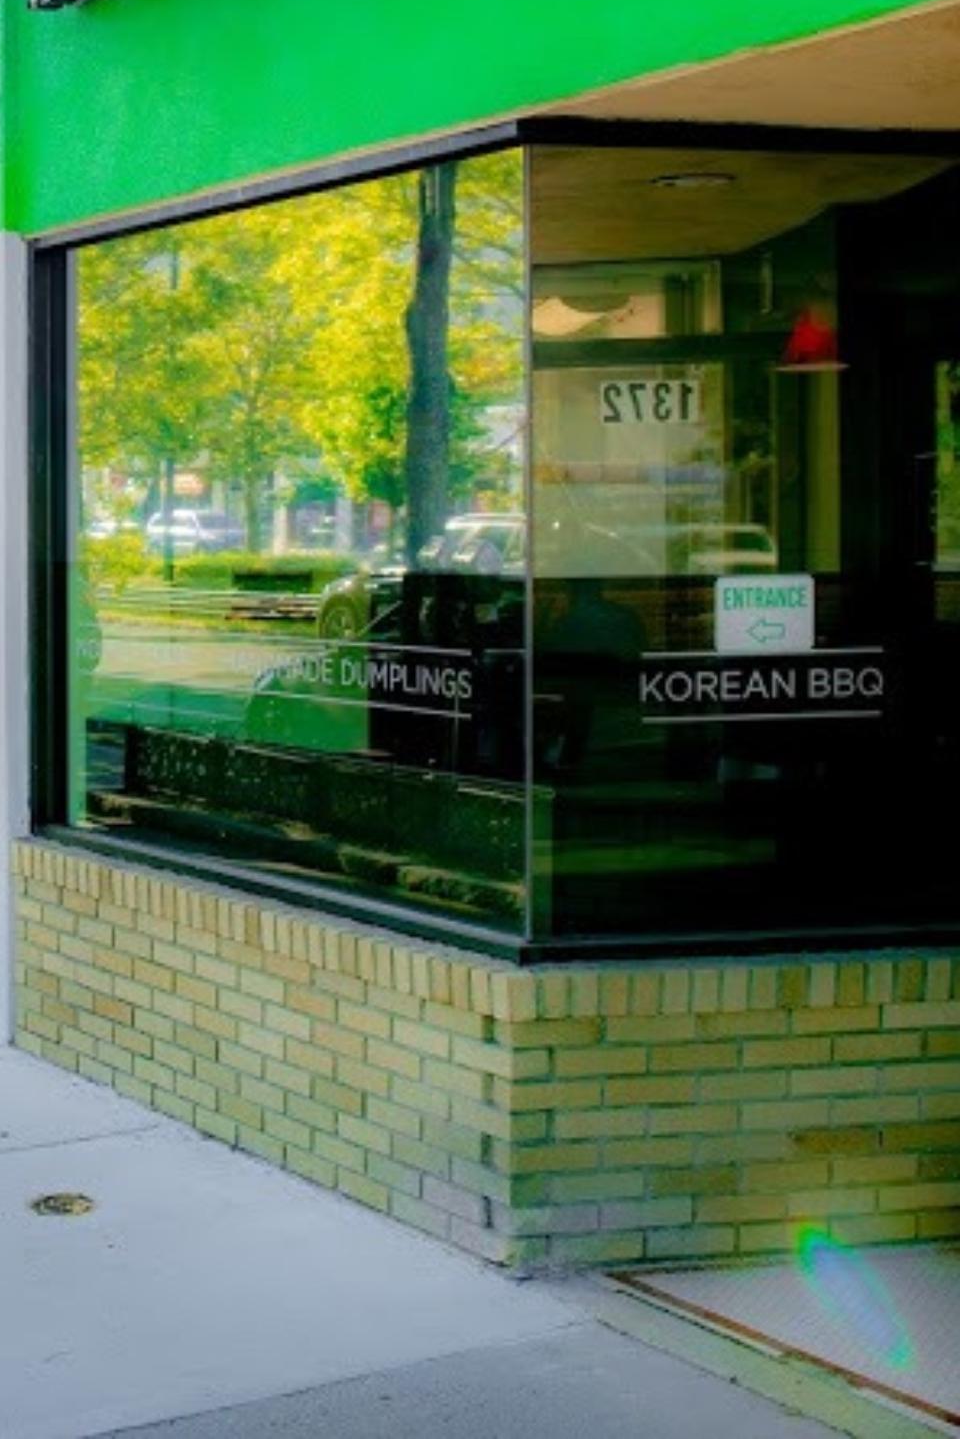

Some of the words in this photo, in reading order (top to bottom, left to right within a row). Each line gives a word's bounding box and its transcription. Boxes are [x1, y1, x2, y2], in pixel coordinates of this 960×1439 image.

[723, 587, 808, 611] ENTRANCE
[341, 659, 473, 699] DUMPLINGS
[640, 669, 797, 703] KOREAN
[808, 667, 884, 699] BBQ
